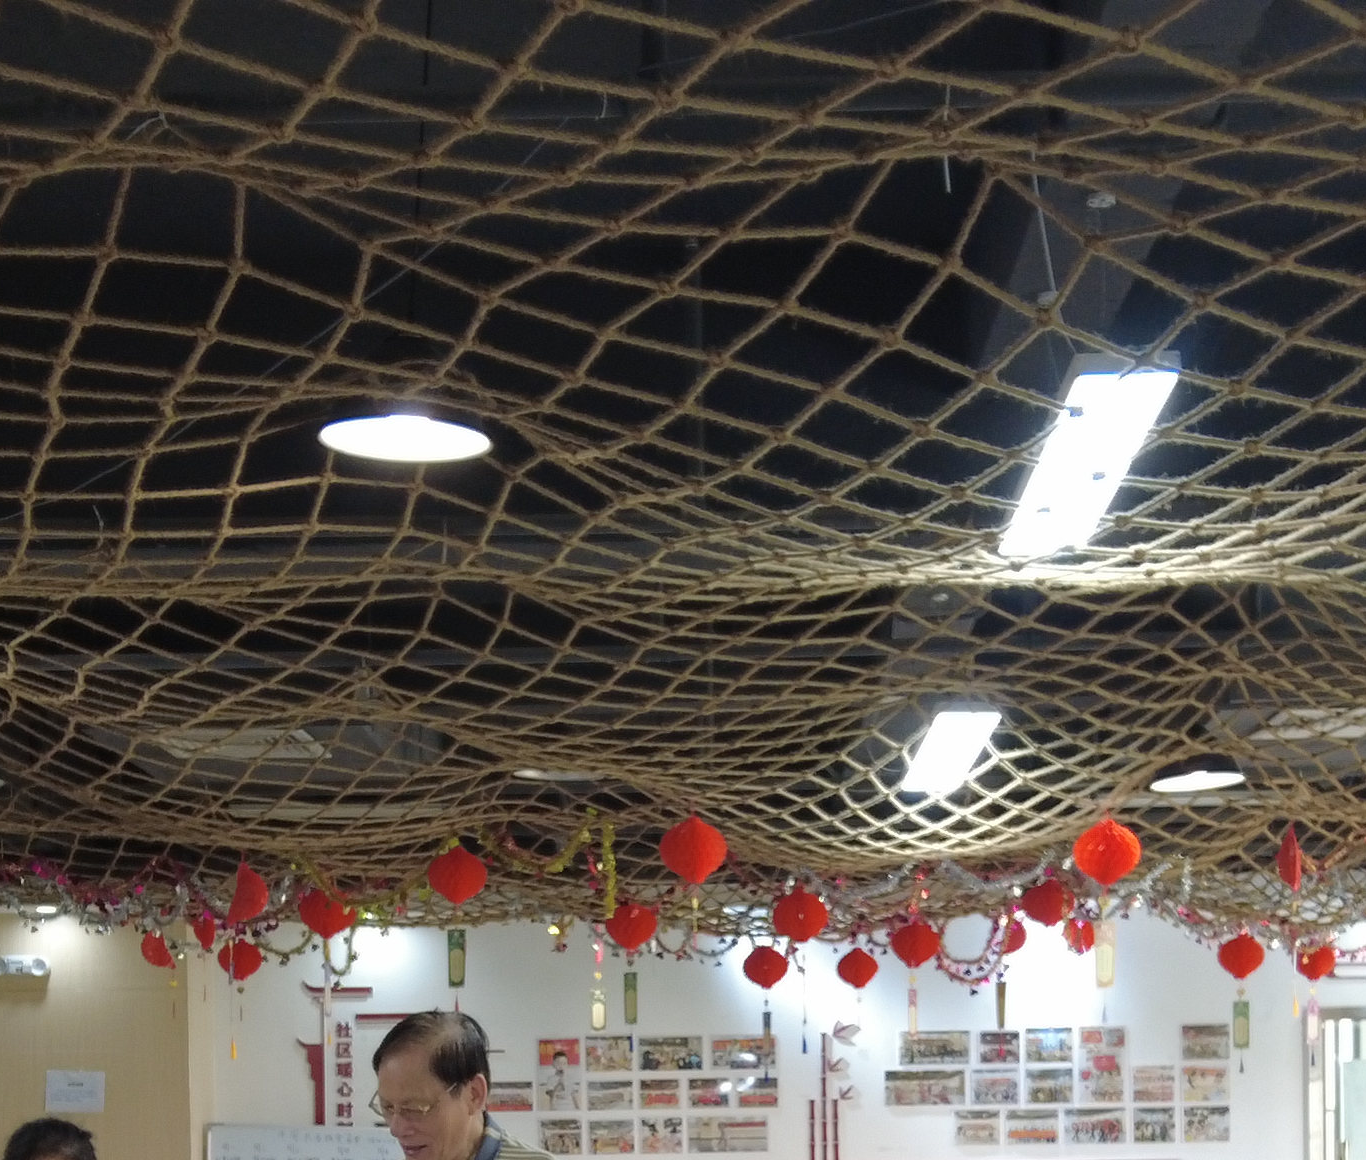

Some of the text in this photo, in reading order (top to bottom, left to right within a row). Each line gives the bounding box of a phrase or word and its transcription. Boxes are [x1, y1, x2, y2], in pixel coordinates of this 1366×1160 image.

[336, 1020, 353, 1126] 社区暖心时
